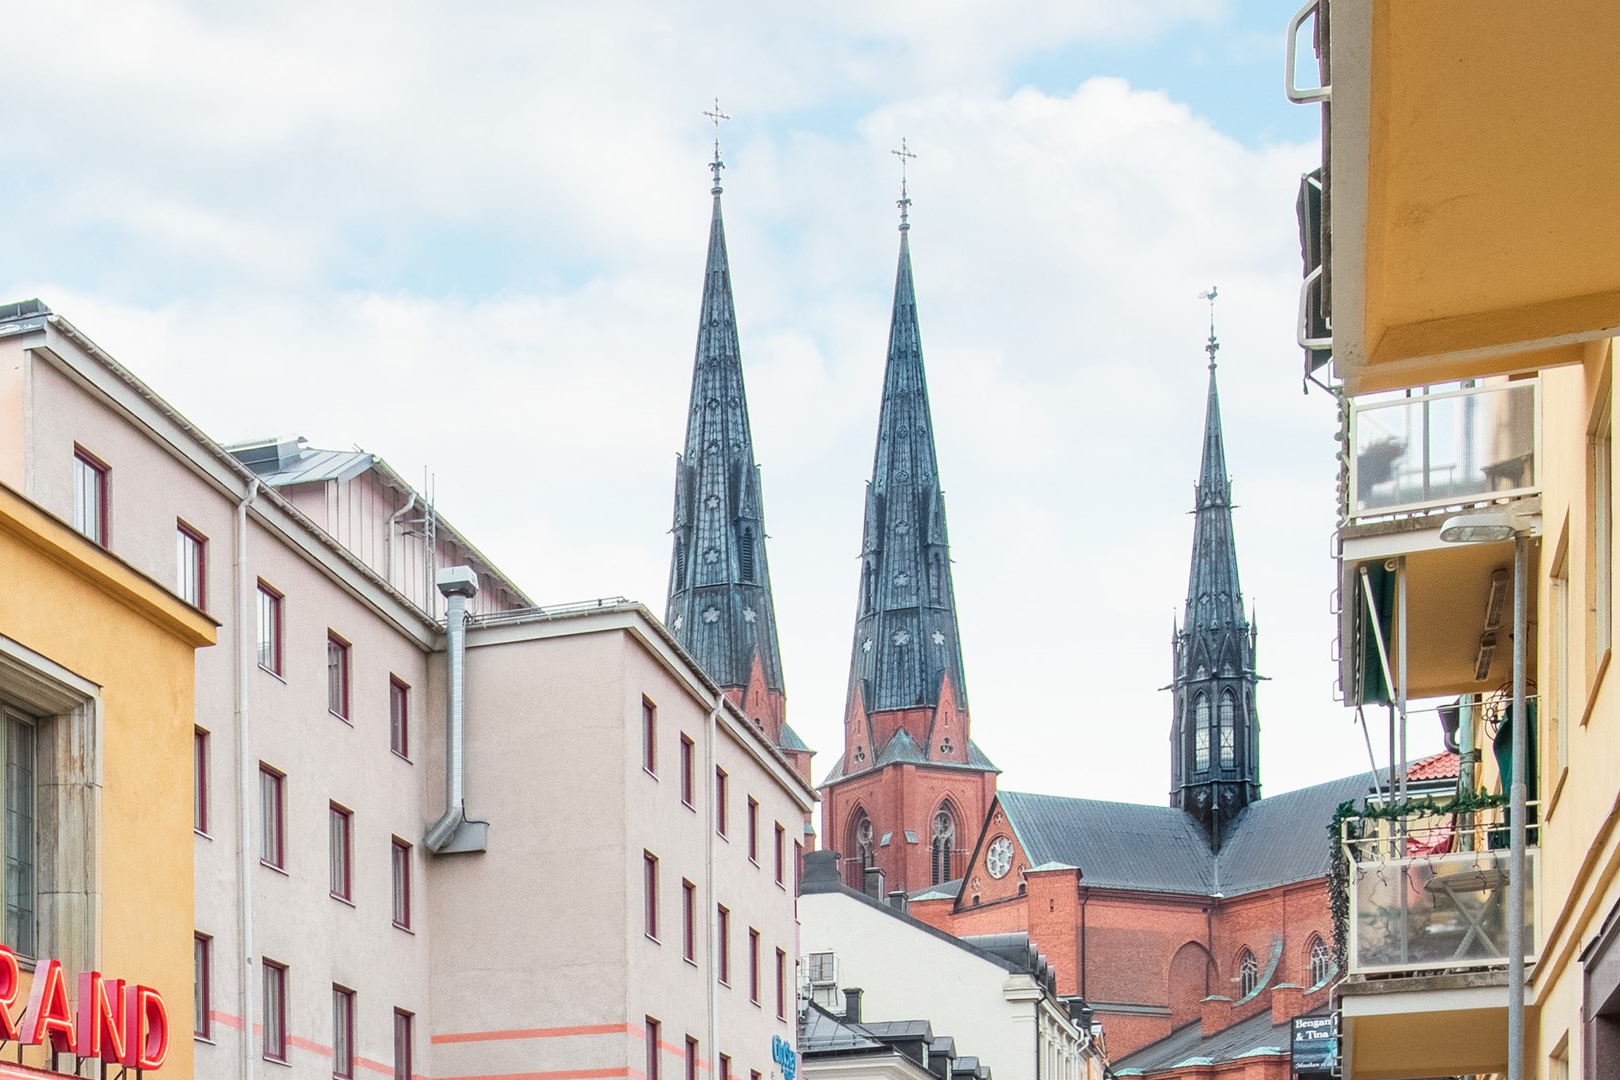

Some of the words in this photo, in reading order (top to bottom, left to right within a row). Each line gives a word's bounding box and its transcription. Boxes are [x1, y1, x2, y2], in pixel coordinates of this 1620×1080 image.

[1295, 1018, 1331, 1029] Bengan
[1295, 1032, 1304, 1042] &
[1305, 1030, 1329, 1040] Tina
